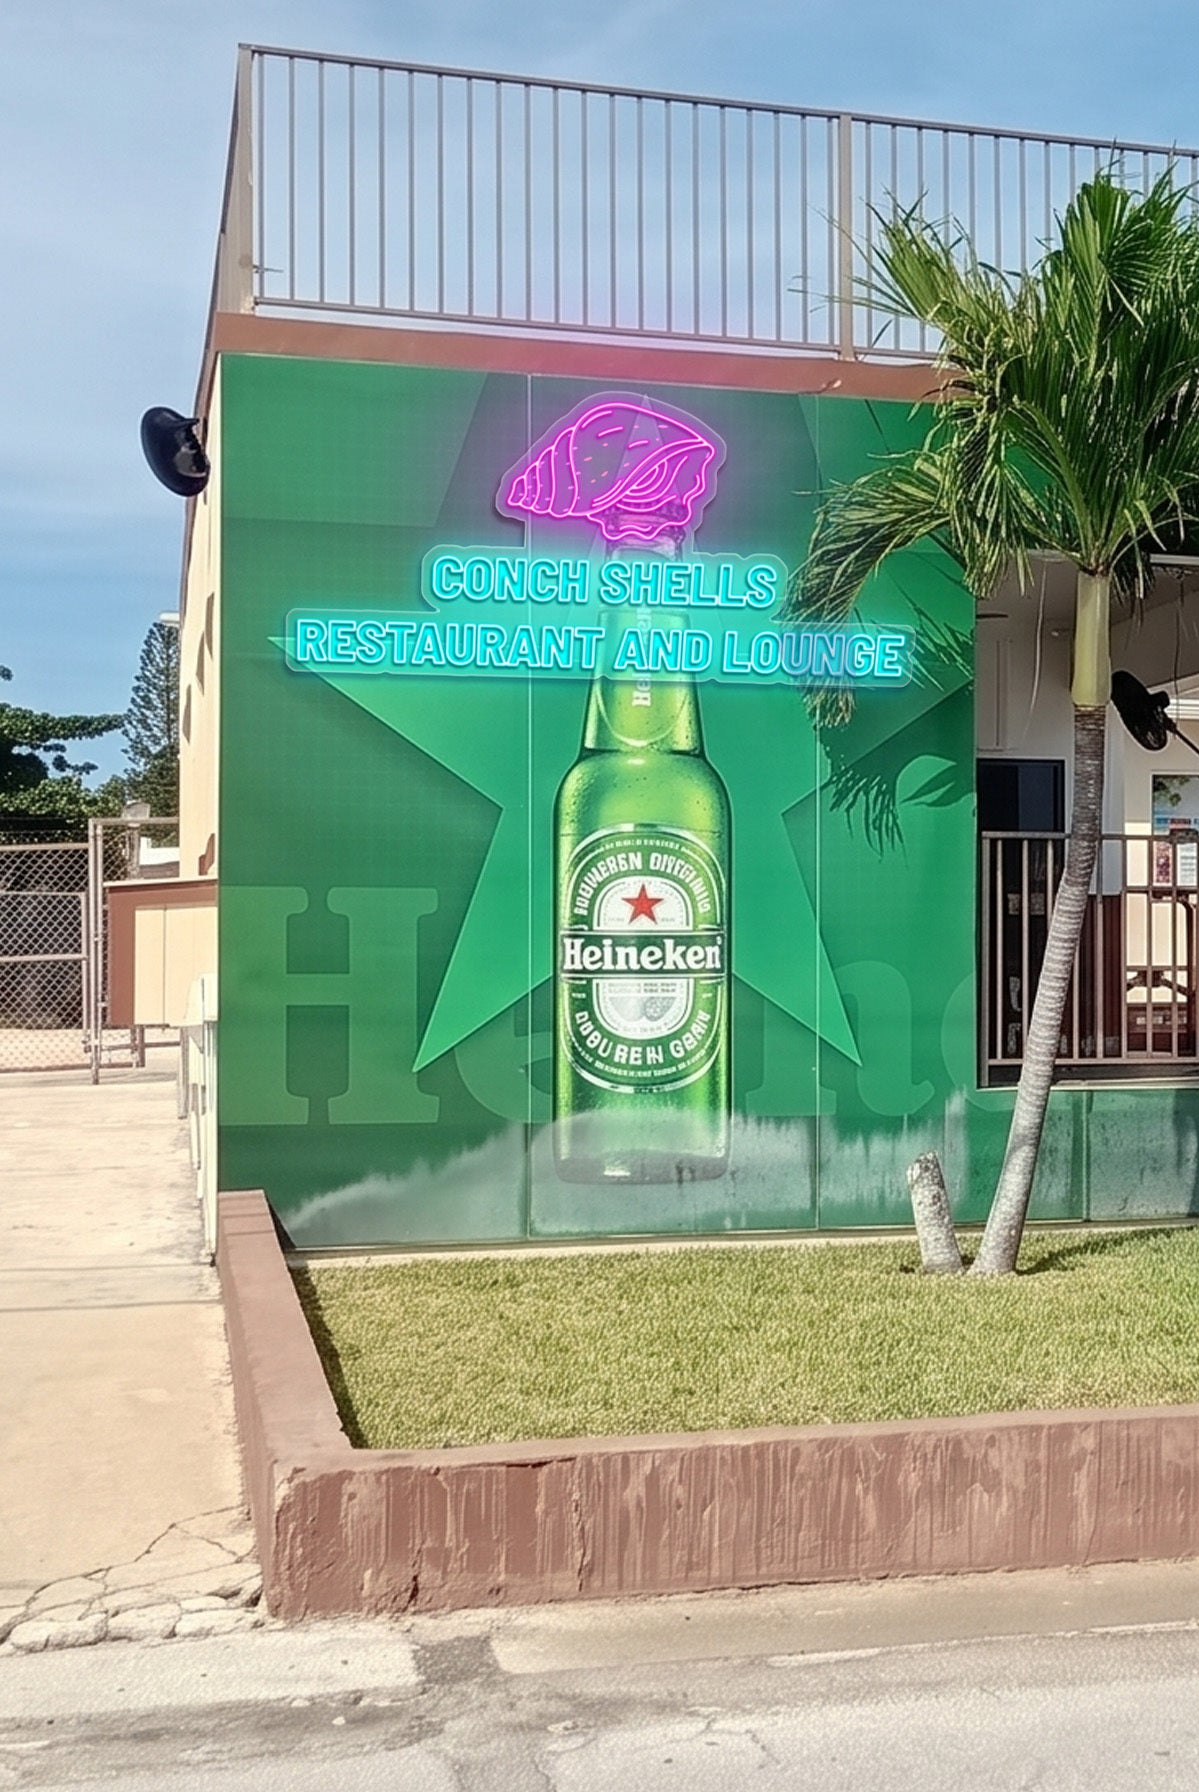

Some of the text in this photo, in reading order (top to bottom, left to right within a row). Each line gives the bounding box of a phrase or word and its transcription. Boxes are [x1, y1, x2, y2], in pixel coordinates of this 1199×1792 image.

[430, 555, 777, 609] CONCH SHELLS
[296, 619, 906, 678] RESTAURANT AND LOUNGE
[562, 938, 722, 971] Heineken
